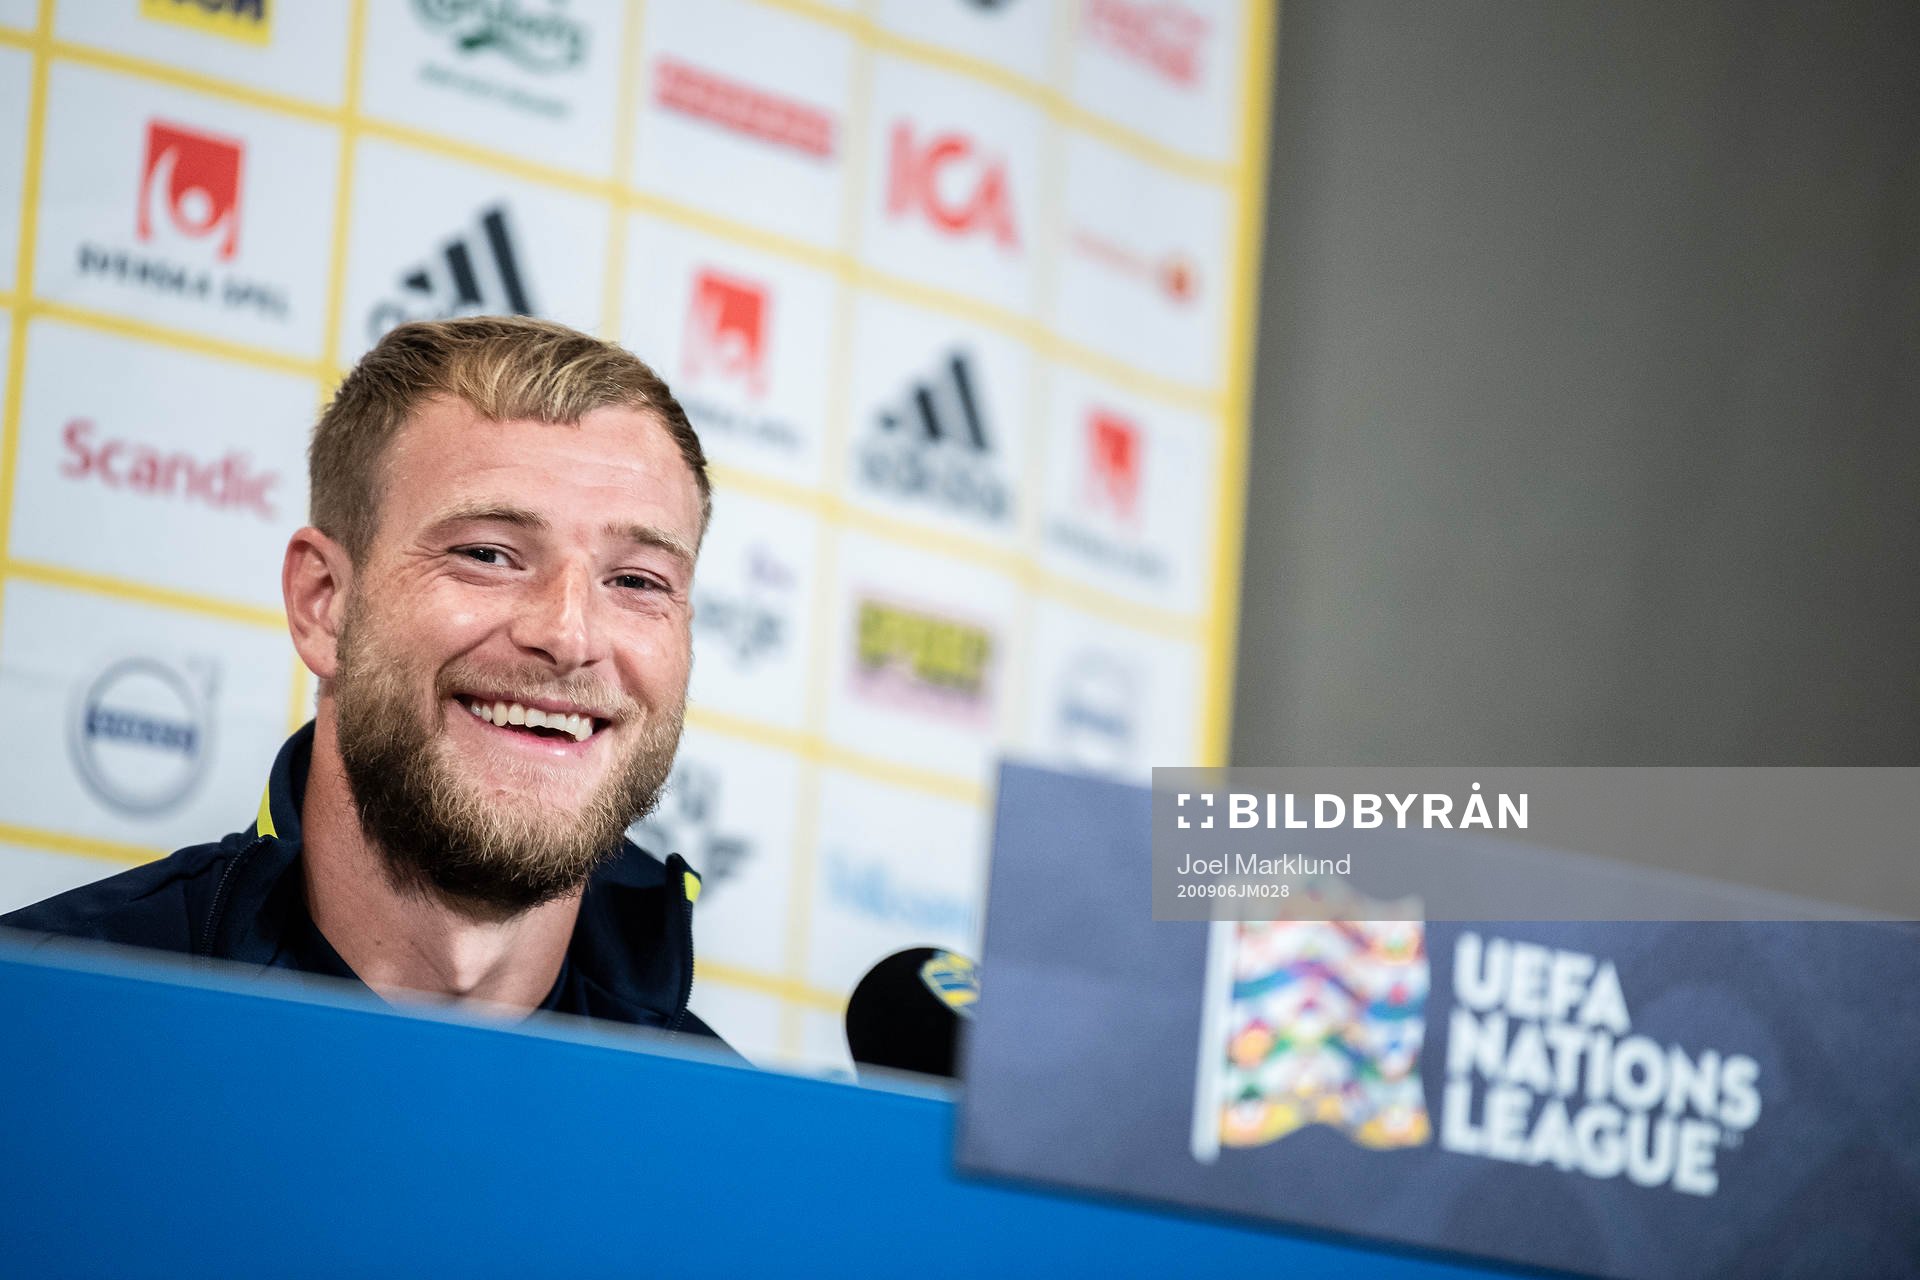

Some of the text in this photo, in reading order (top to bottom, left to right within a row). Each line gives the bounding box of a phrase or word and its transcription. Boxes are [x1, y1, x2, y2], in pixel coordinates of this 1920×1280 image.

[886, 119, 1019, 252] ICA
[78, 242, 212, 298] SVENSKA
[61, 417, 279, 519] Scandic
[1454, 930, 1632, 1036] UEFA
[1447, 1006, 1762, 1132] NATIONS
[1441, 1079, 1721, 1197] LEAGUE
